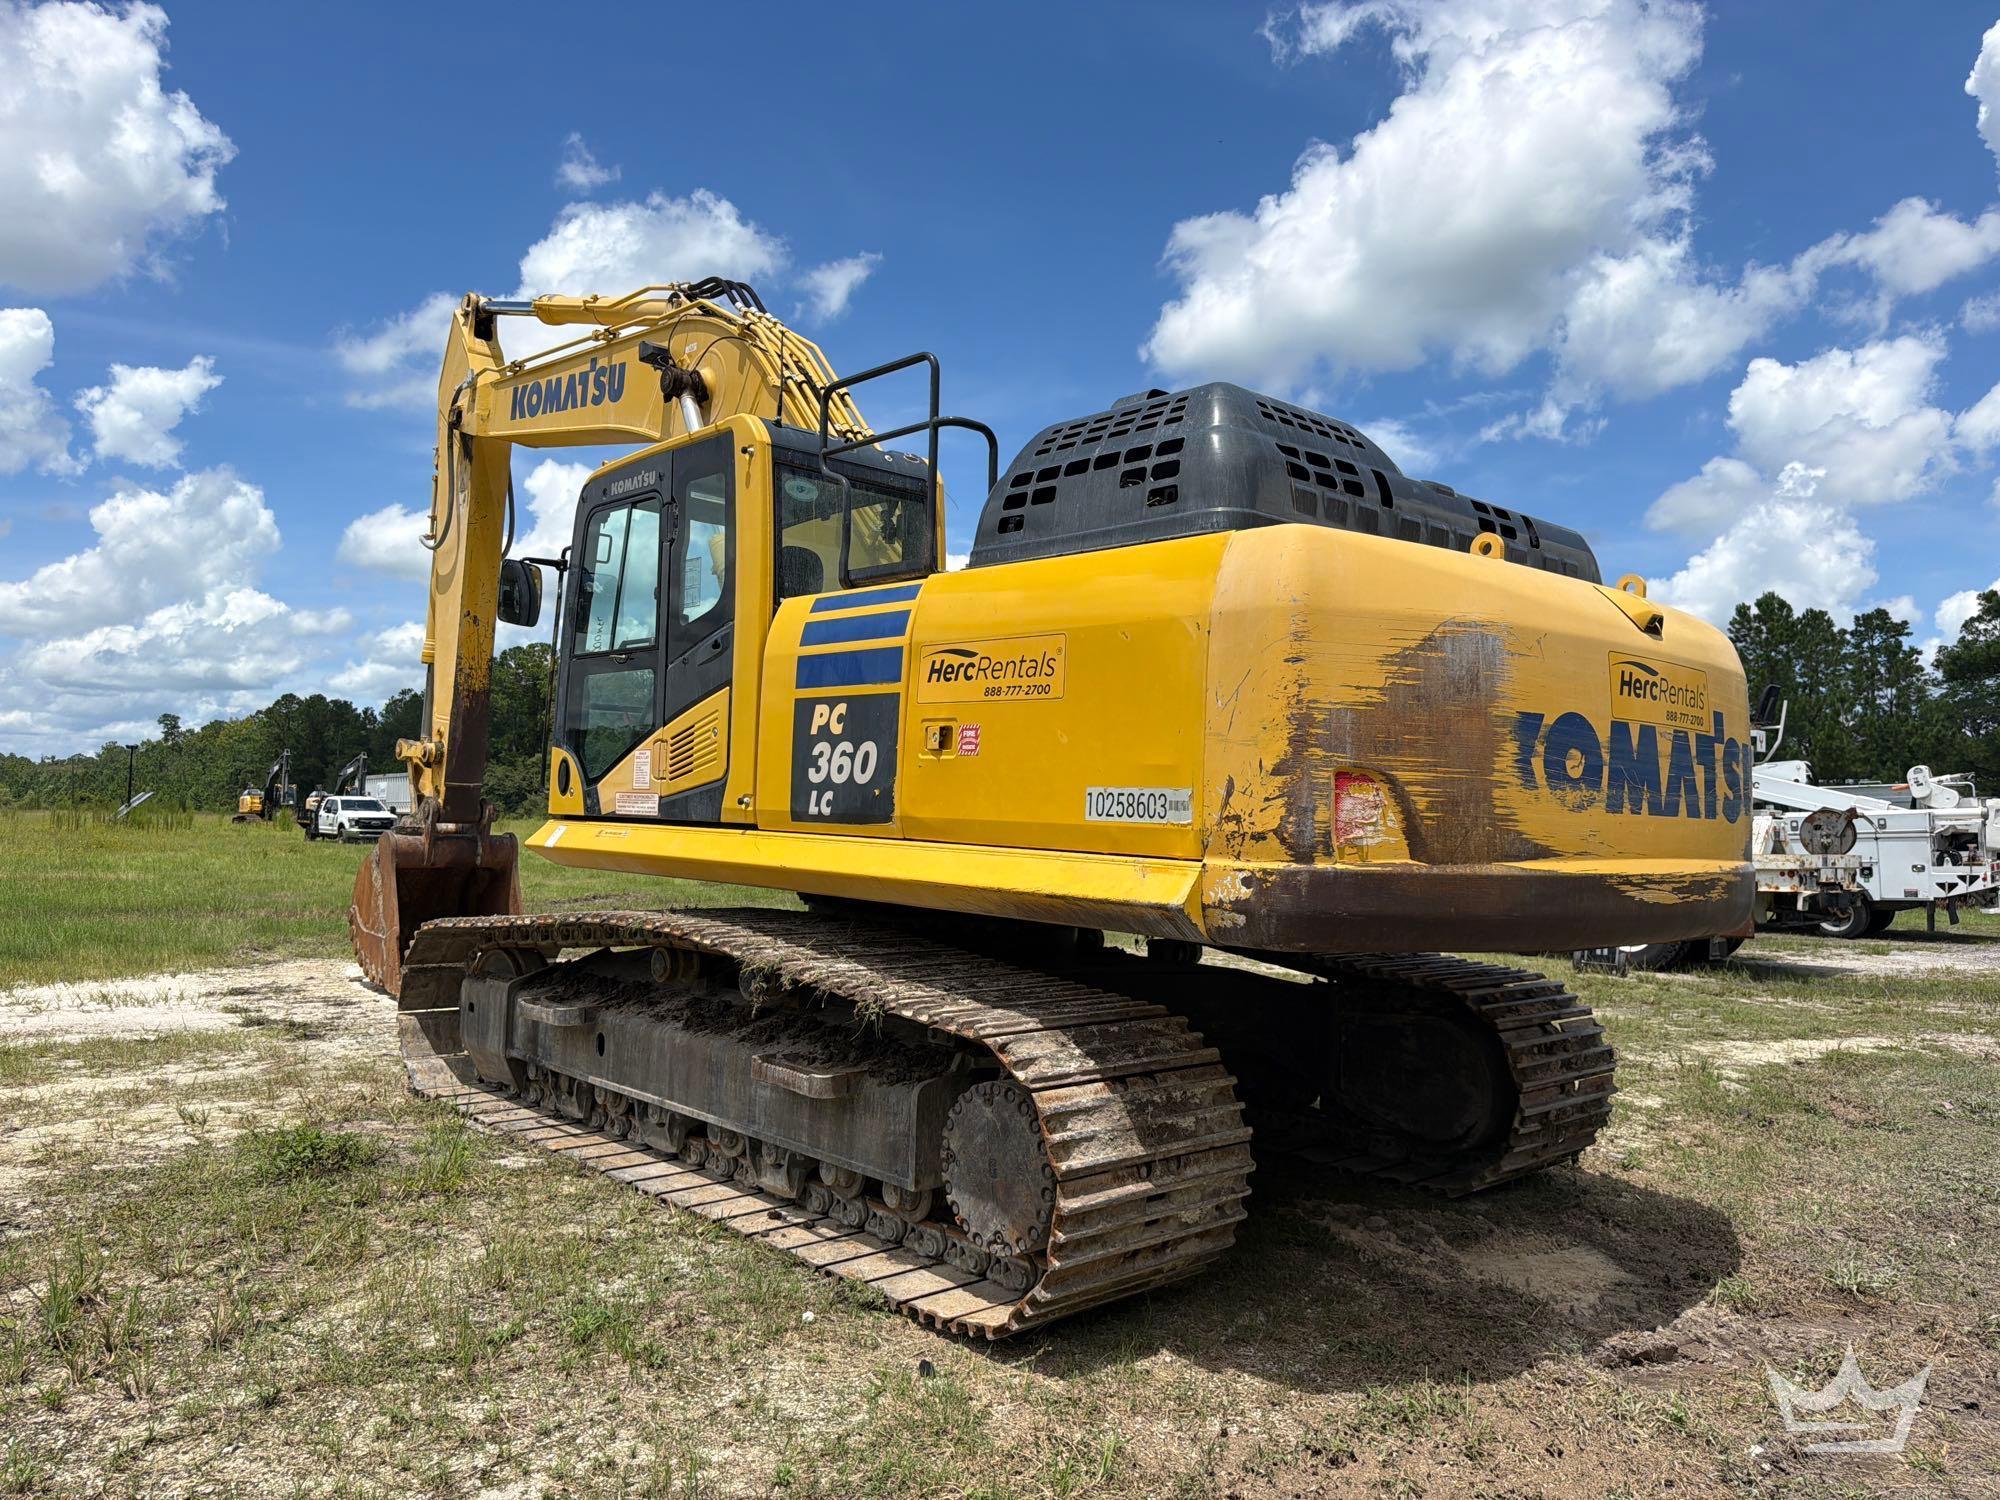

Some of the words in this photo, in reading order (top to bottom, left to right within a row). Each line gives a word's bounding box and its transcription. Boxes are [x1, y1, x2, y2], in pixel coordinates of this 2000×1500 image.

[510, 357, 627, 421] KOMATSU
[611, 470, 656, 496] KOMATSU
[927, 651, 1057, 683] HercRentals
[984, 684, 1051, 697] 888-777-2700
[1619, 669, 1705, 710] HercRentals
[810, 702, 848, 735] PC
[1666, 710, 1704, 727] 888-777-2700
[963, 730, 976, 738] FIRE
[808, 741, 878, 785] 360
[808, 790, 834, 816] LC
[1087, 792, 1167, 819] 10258603
